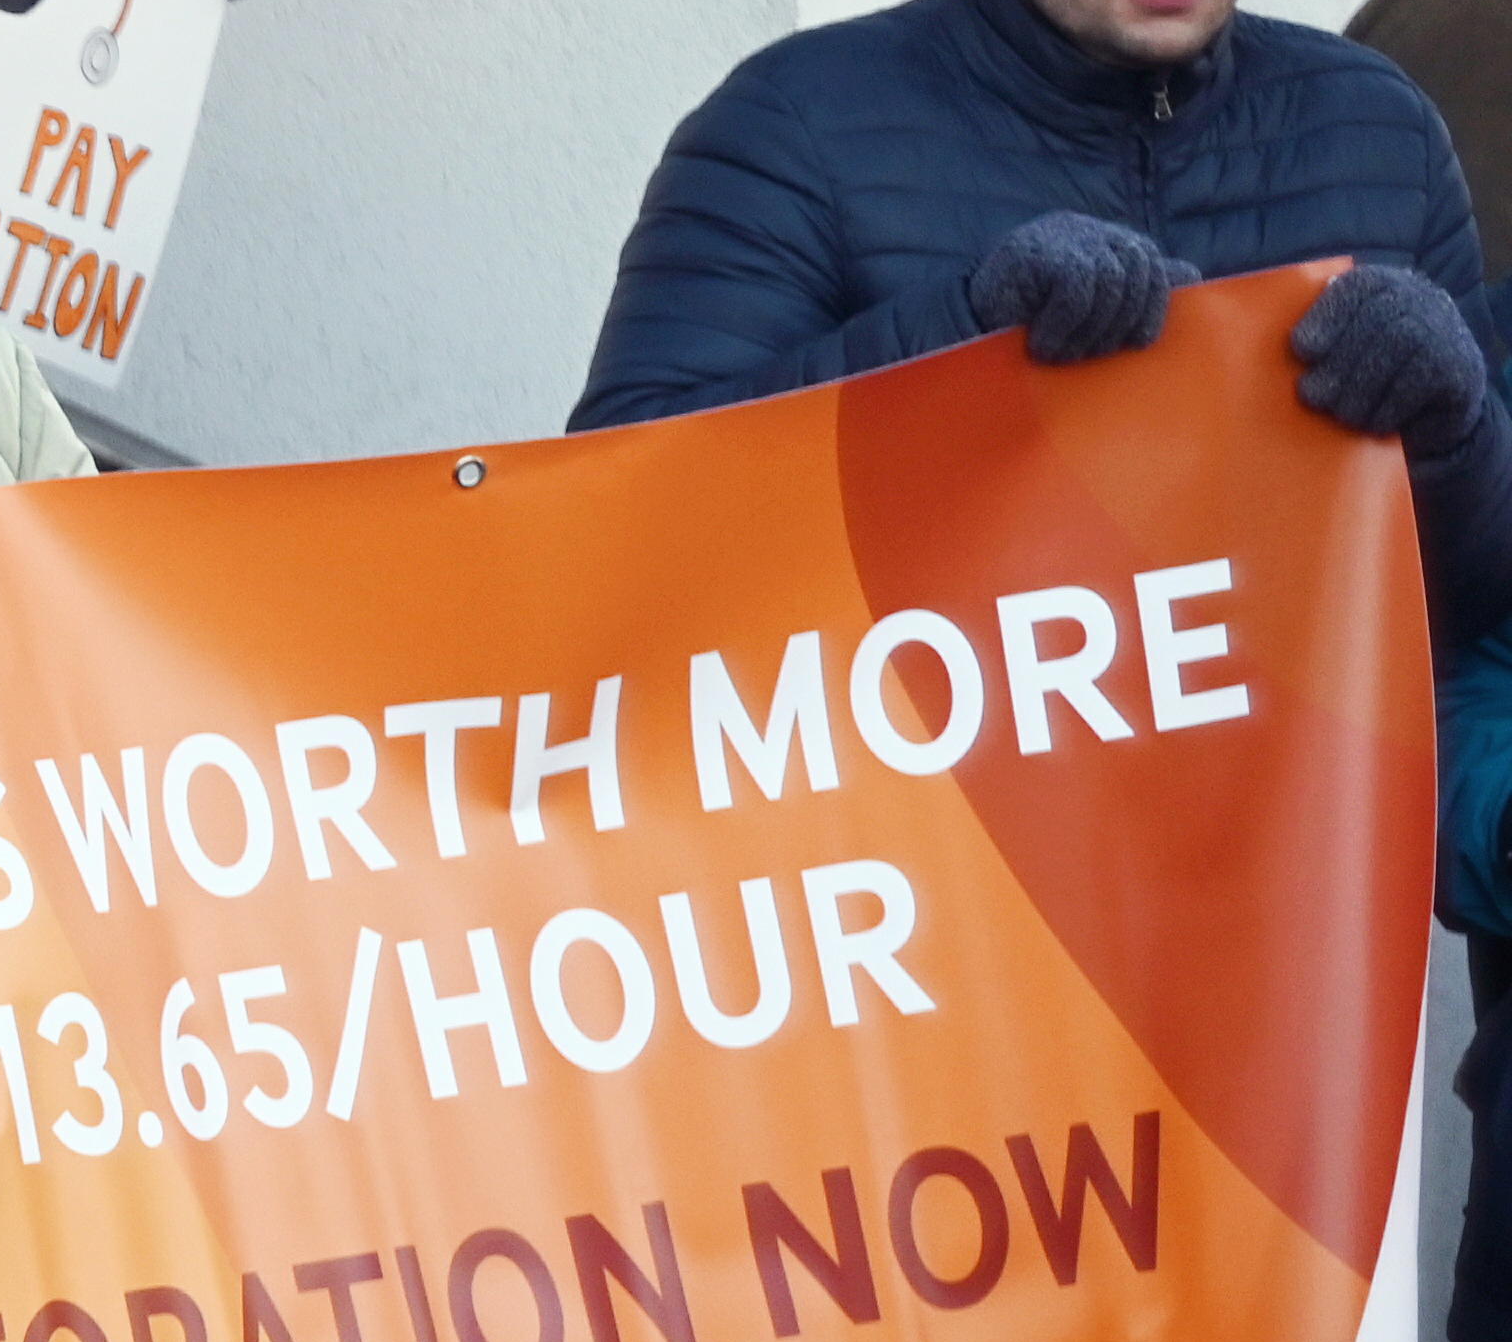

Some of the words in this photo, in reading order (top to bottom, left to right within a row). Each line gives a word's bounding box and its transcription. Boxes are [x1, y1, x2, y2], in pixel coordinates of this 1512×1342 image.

[20, 105, 151, 230] PAY
[34, 674, 624, 915] WORTH
[689, 556, 1251, 814] MORE
[742, 1109, 1161, 1340] NOW
